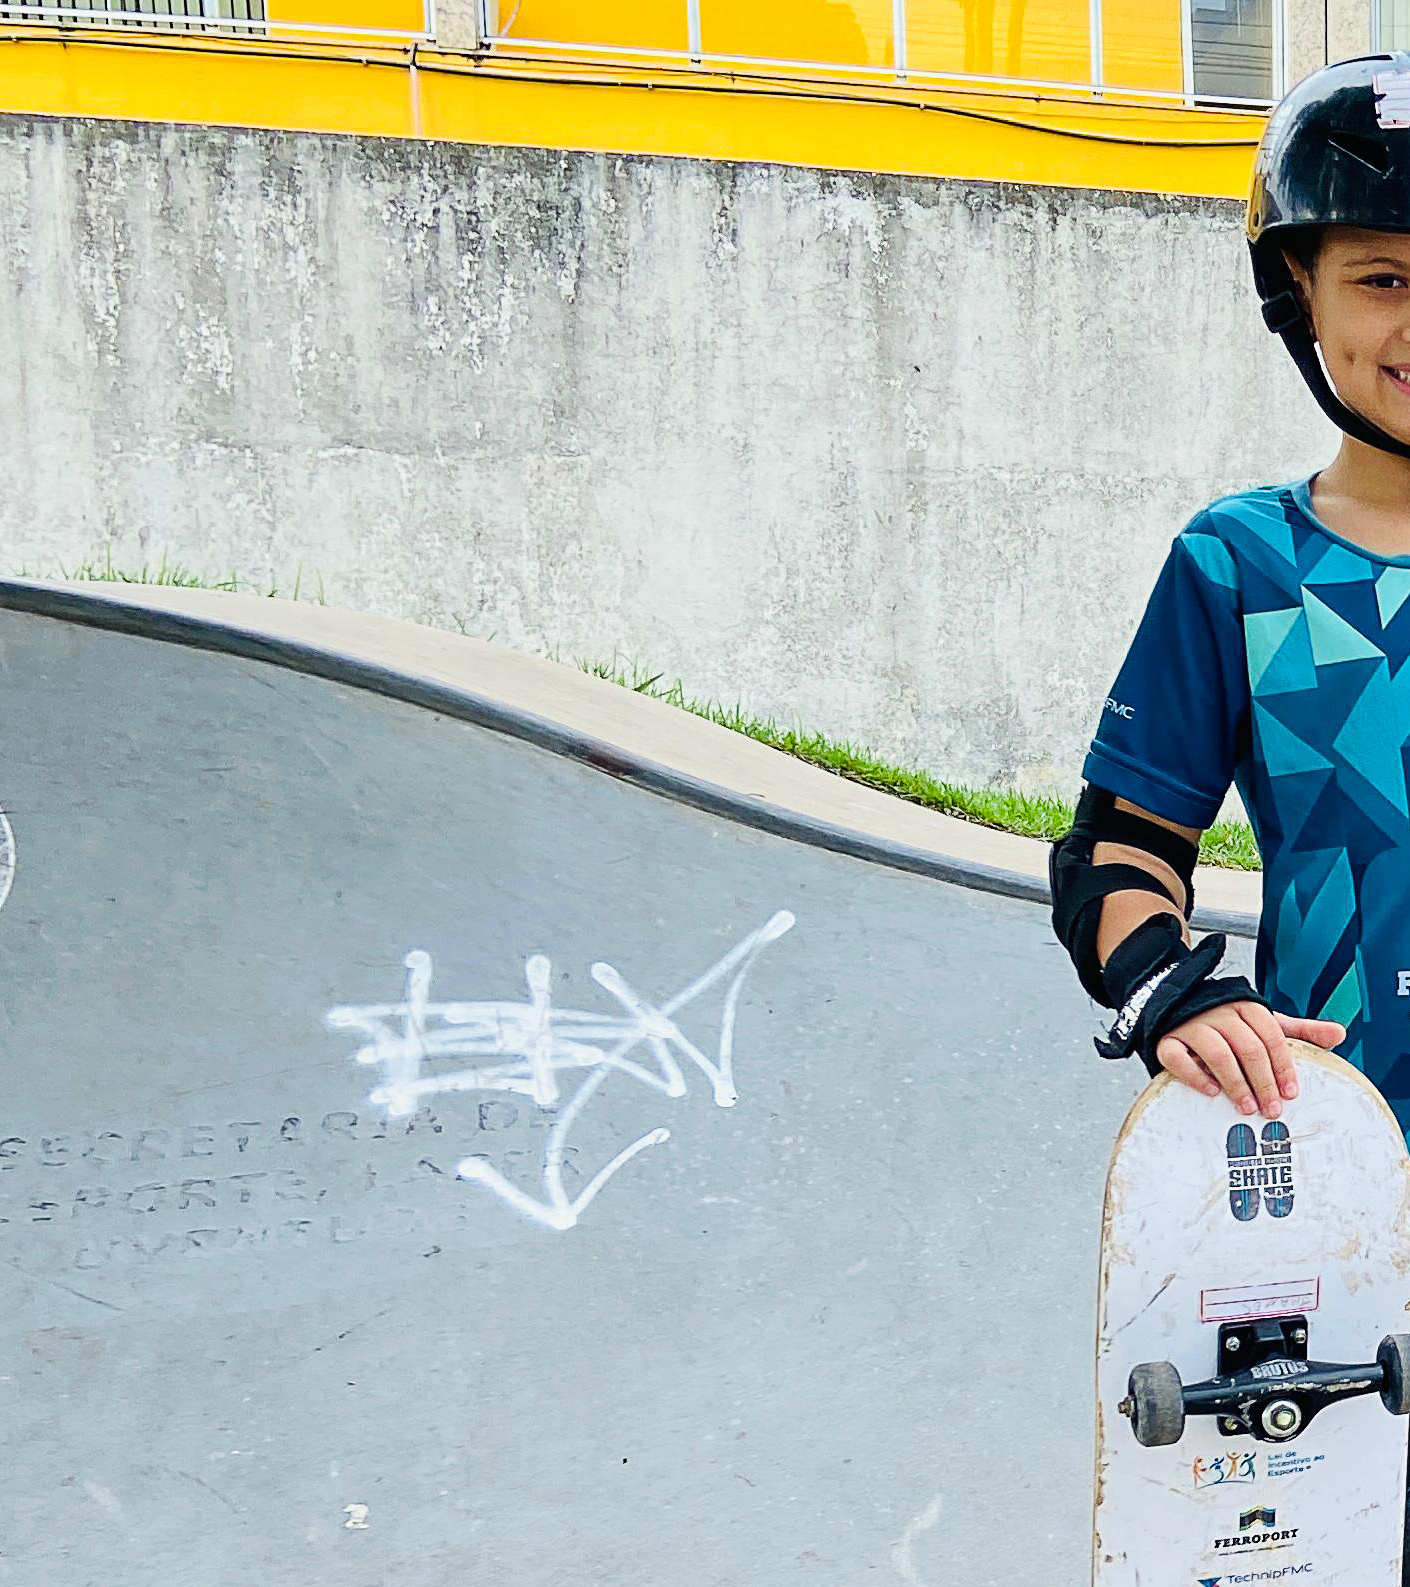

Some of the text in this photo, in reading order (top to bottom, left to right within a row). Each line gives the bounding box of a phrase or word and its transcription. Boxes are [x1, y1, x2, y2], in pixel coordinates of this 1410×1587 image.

[1228, 1165, 1292, 1187] SKATE
[1250, 1361, 1309, 1379] BRUTUS
[1214, 1528, 1299, 1549] FERROPORT
[1226, 1562, 1314, 1584] TechnipFMC
